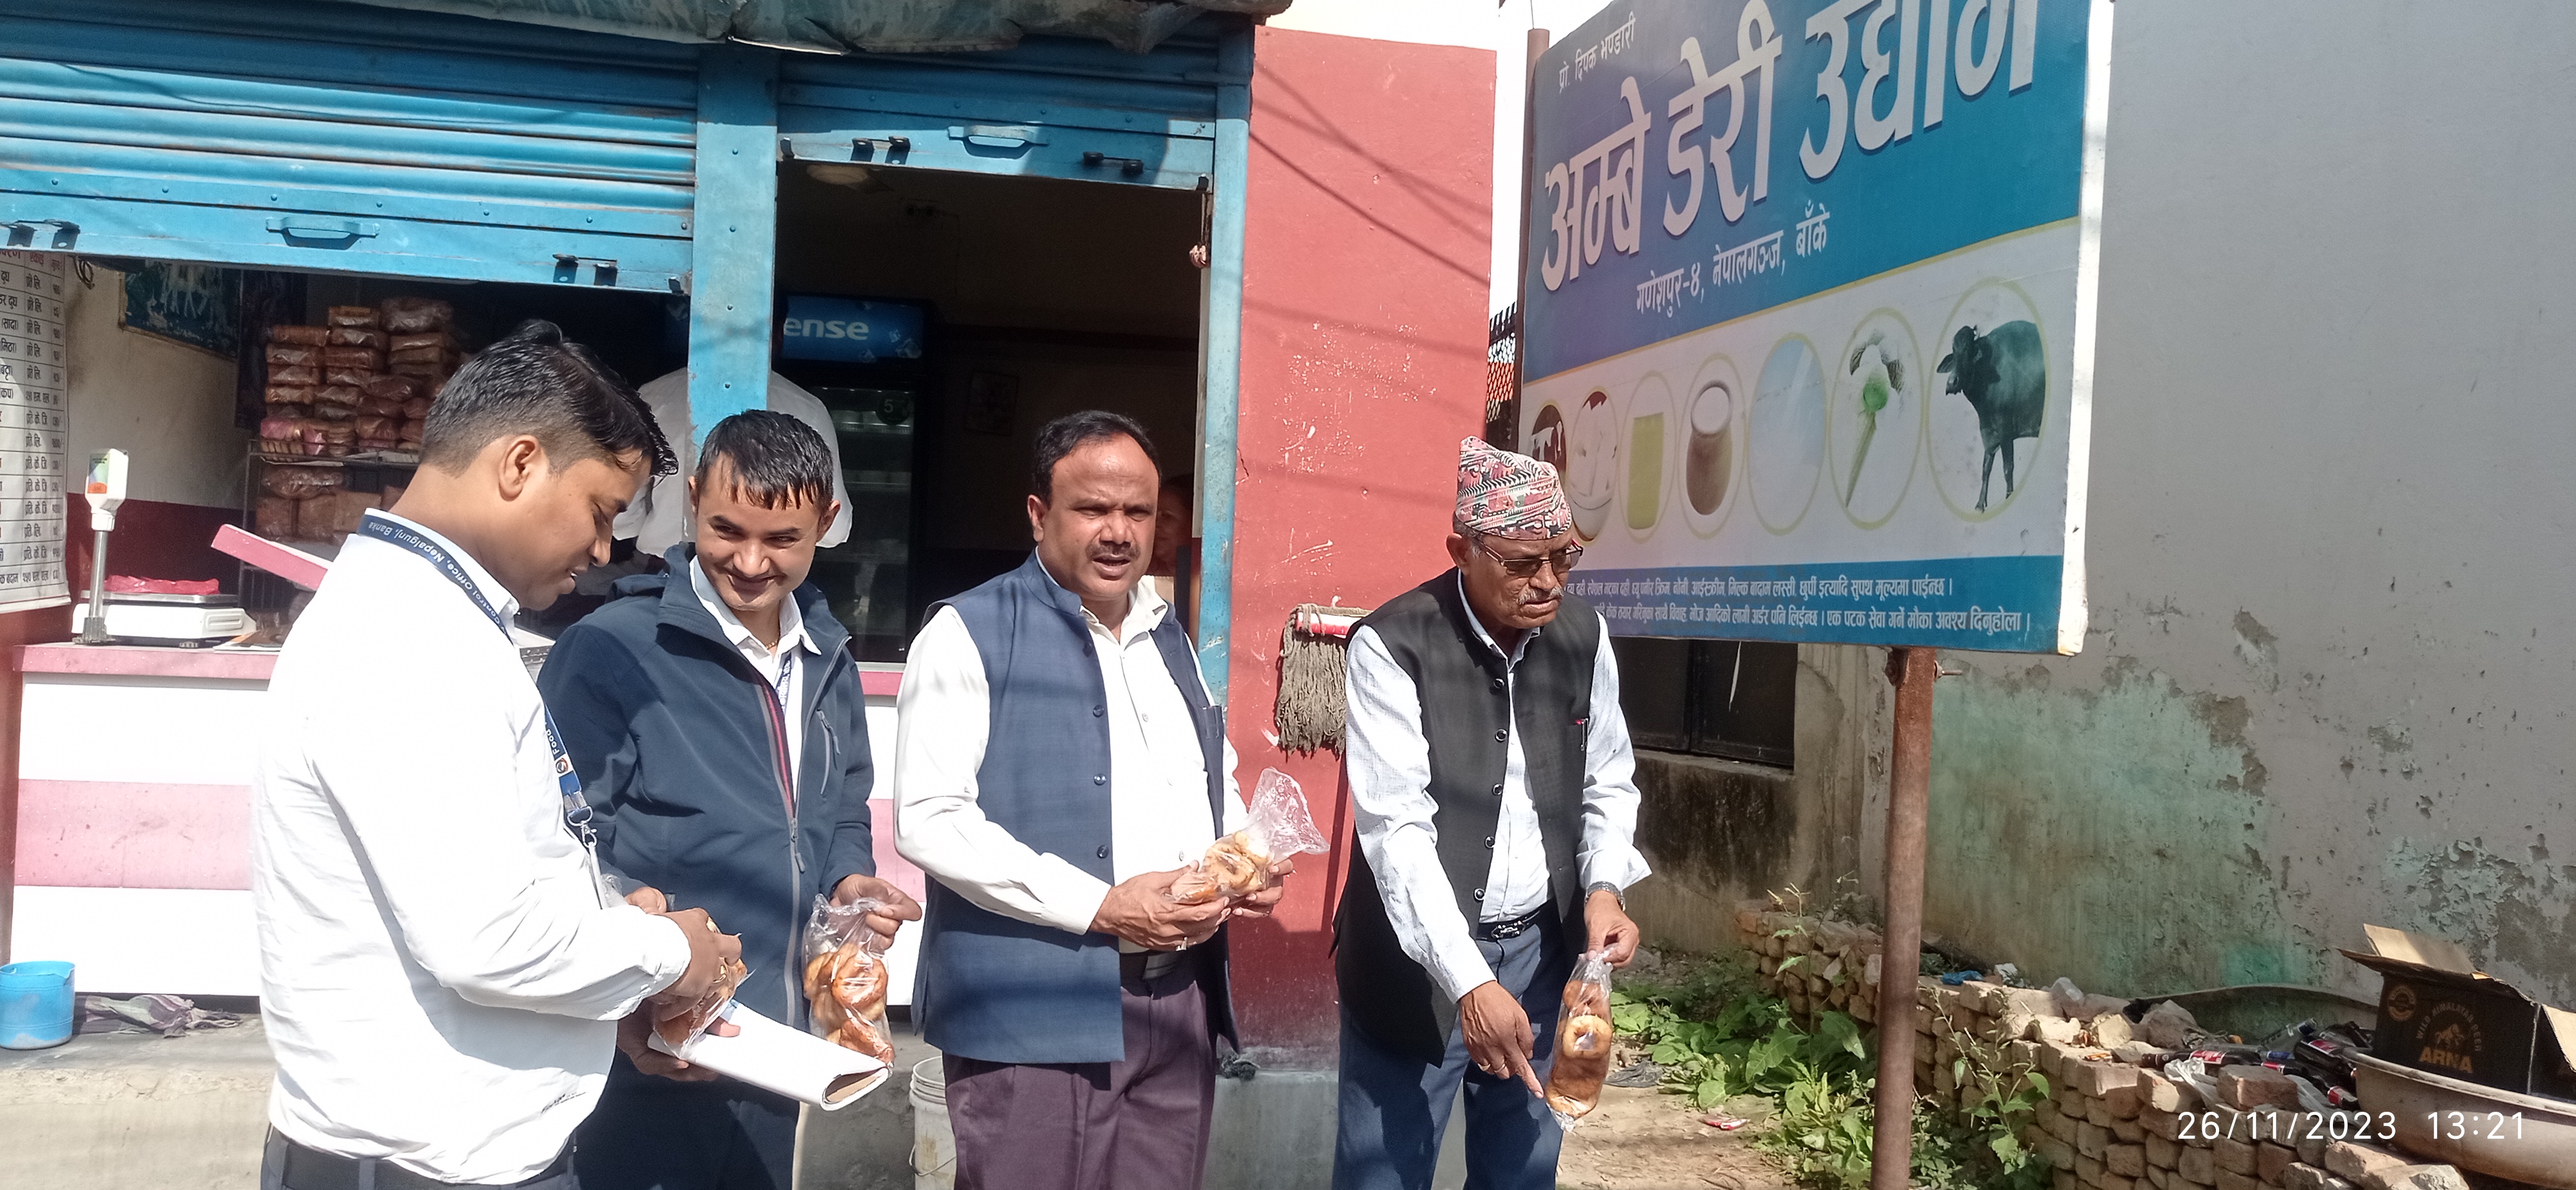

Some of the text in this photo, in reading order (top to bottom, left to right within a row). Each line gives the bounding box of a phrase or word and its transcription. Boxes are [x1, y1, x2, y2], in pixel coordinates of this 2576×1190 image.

[1575, 45, 1598, 81] दिपक
[1600, 11, 1636, 60] भण्डारी
[1541, 76, 1651, 291] अम्बे
[1663, 0, 1783, 237] डेरी
[1796, 199, 1830, 257] बाँके
[394, 528, 445, 563] Nepalgunj,
[447, 559, 473, 590] Office,
[1818, 574, 1849, 599] इत्यादि
[1851, 579, 1874, 601] सुपथ
[1875, 579, 1909, 601] मूल्यमा
[473, 590, 500, 624] Control
[1705, 603, 1731, 623] आदिको
[1771, 605, 1787, 625] पनि
[1827, 610, 1842, 626] एक
[1844, 611, 1866, 627] पटक
[1868, 606, 1886, 629] सेवा
[1888, 606, 1905, 629] गर्ने
[1907, 605, 1933, 629] मौका
[1935, 612, 1968, 631] अवश्य
[1970, 605, 2022, 636] दिनुहोला
[2420, 1046, 2473, 1073] ARNA
